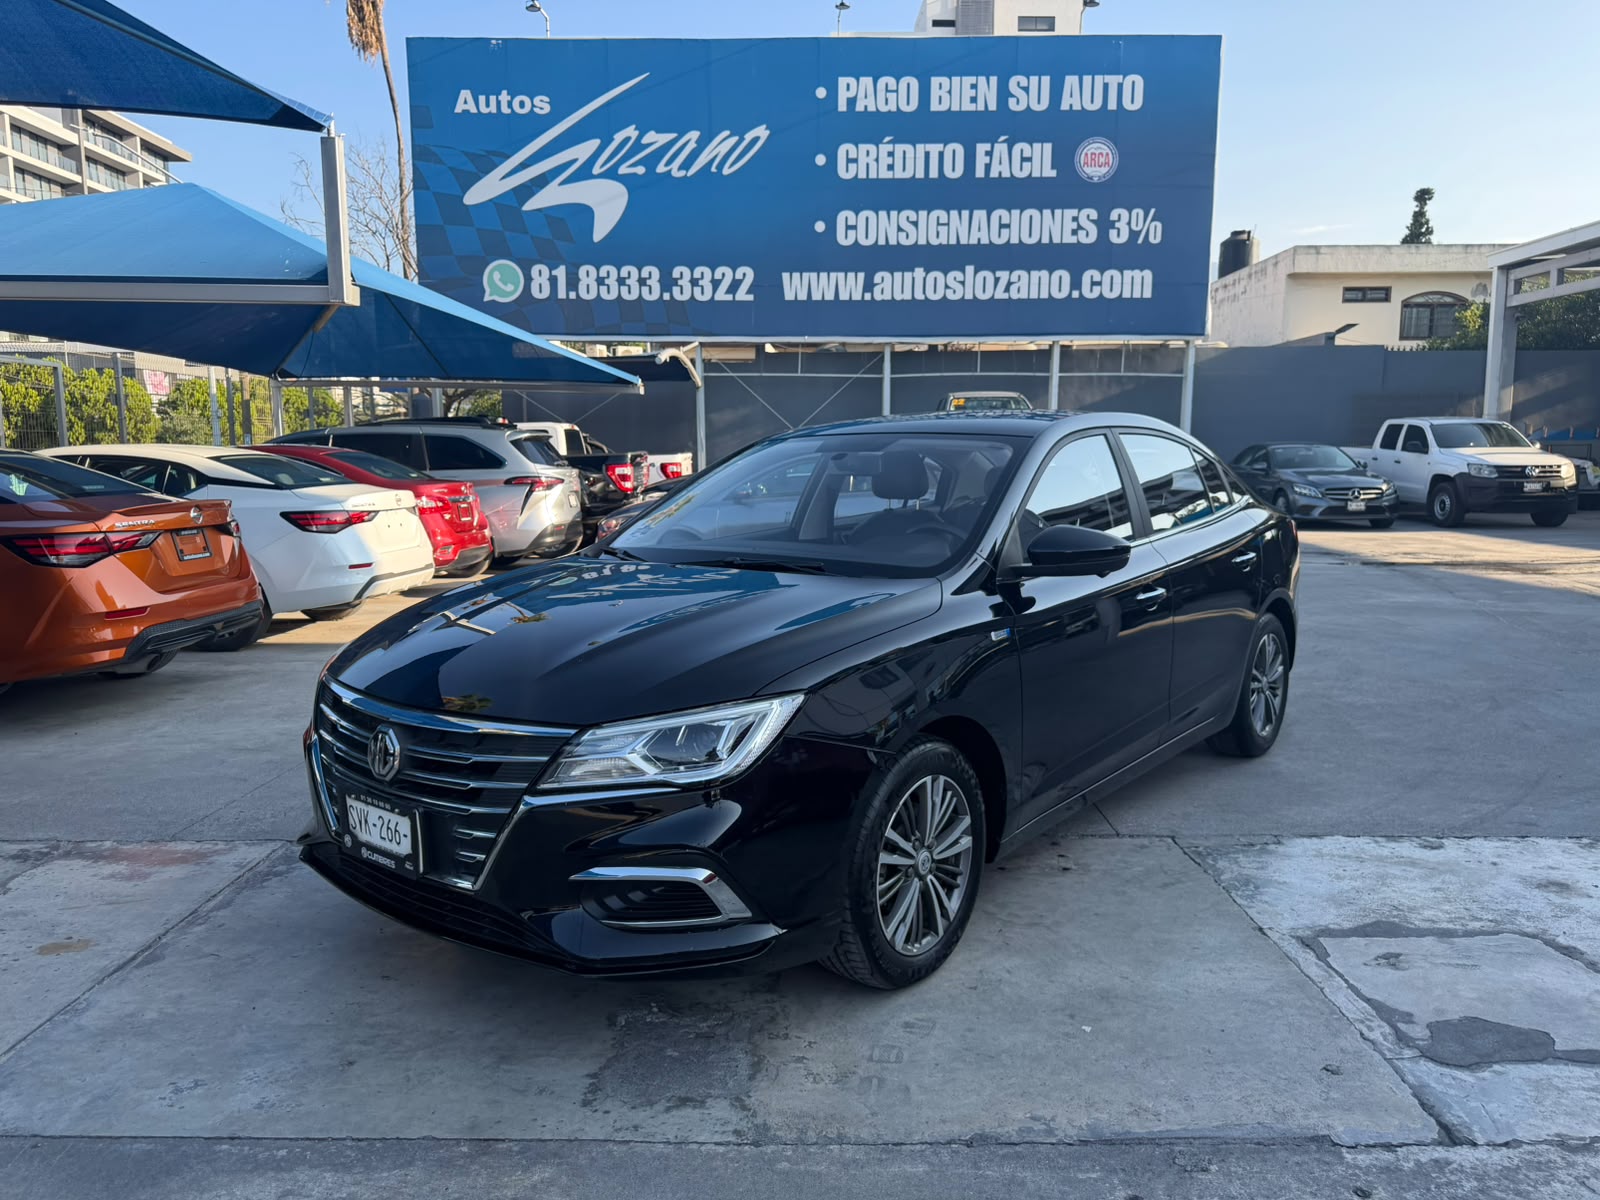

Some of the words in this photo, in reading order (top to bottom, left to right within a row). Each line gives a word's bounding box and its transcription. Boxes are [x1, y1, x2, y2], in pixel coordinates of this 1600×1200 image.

[454, 89, 551, 115] Autos
[837, 76, 919, 112] PAGO
[930, 75, 998, 111] BIEN
[1008, 75, 1050, 111] SU
[1060, 74, 1144, 110] AUTO
[463, 72, 770, 243] Lozano
[837, 137, 965, 179] CRÉDITO
[975, 136, 1057, 178] FÁCIL
[1083, 151, 1110, 168] ARCA
[836, 208, 1098, 247] CONSIGNACIONES
[1109, 207, 1162, 245] 3%
[530, 263, 755, 301] 81.8333.3322
[782, 265, 1153, 302] www.autoslozano.com
